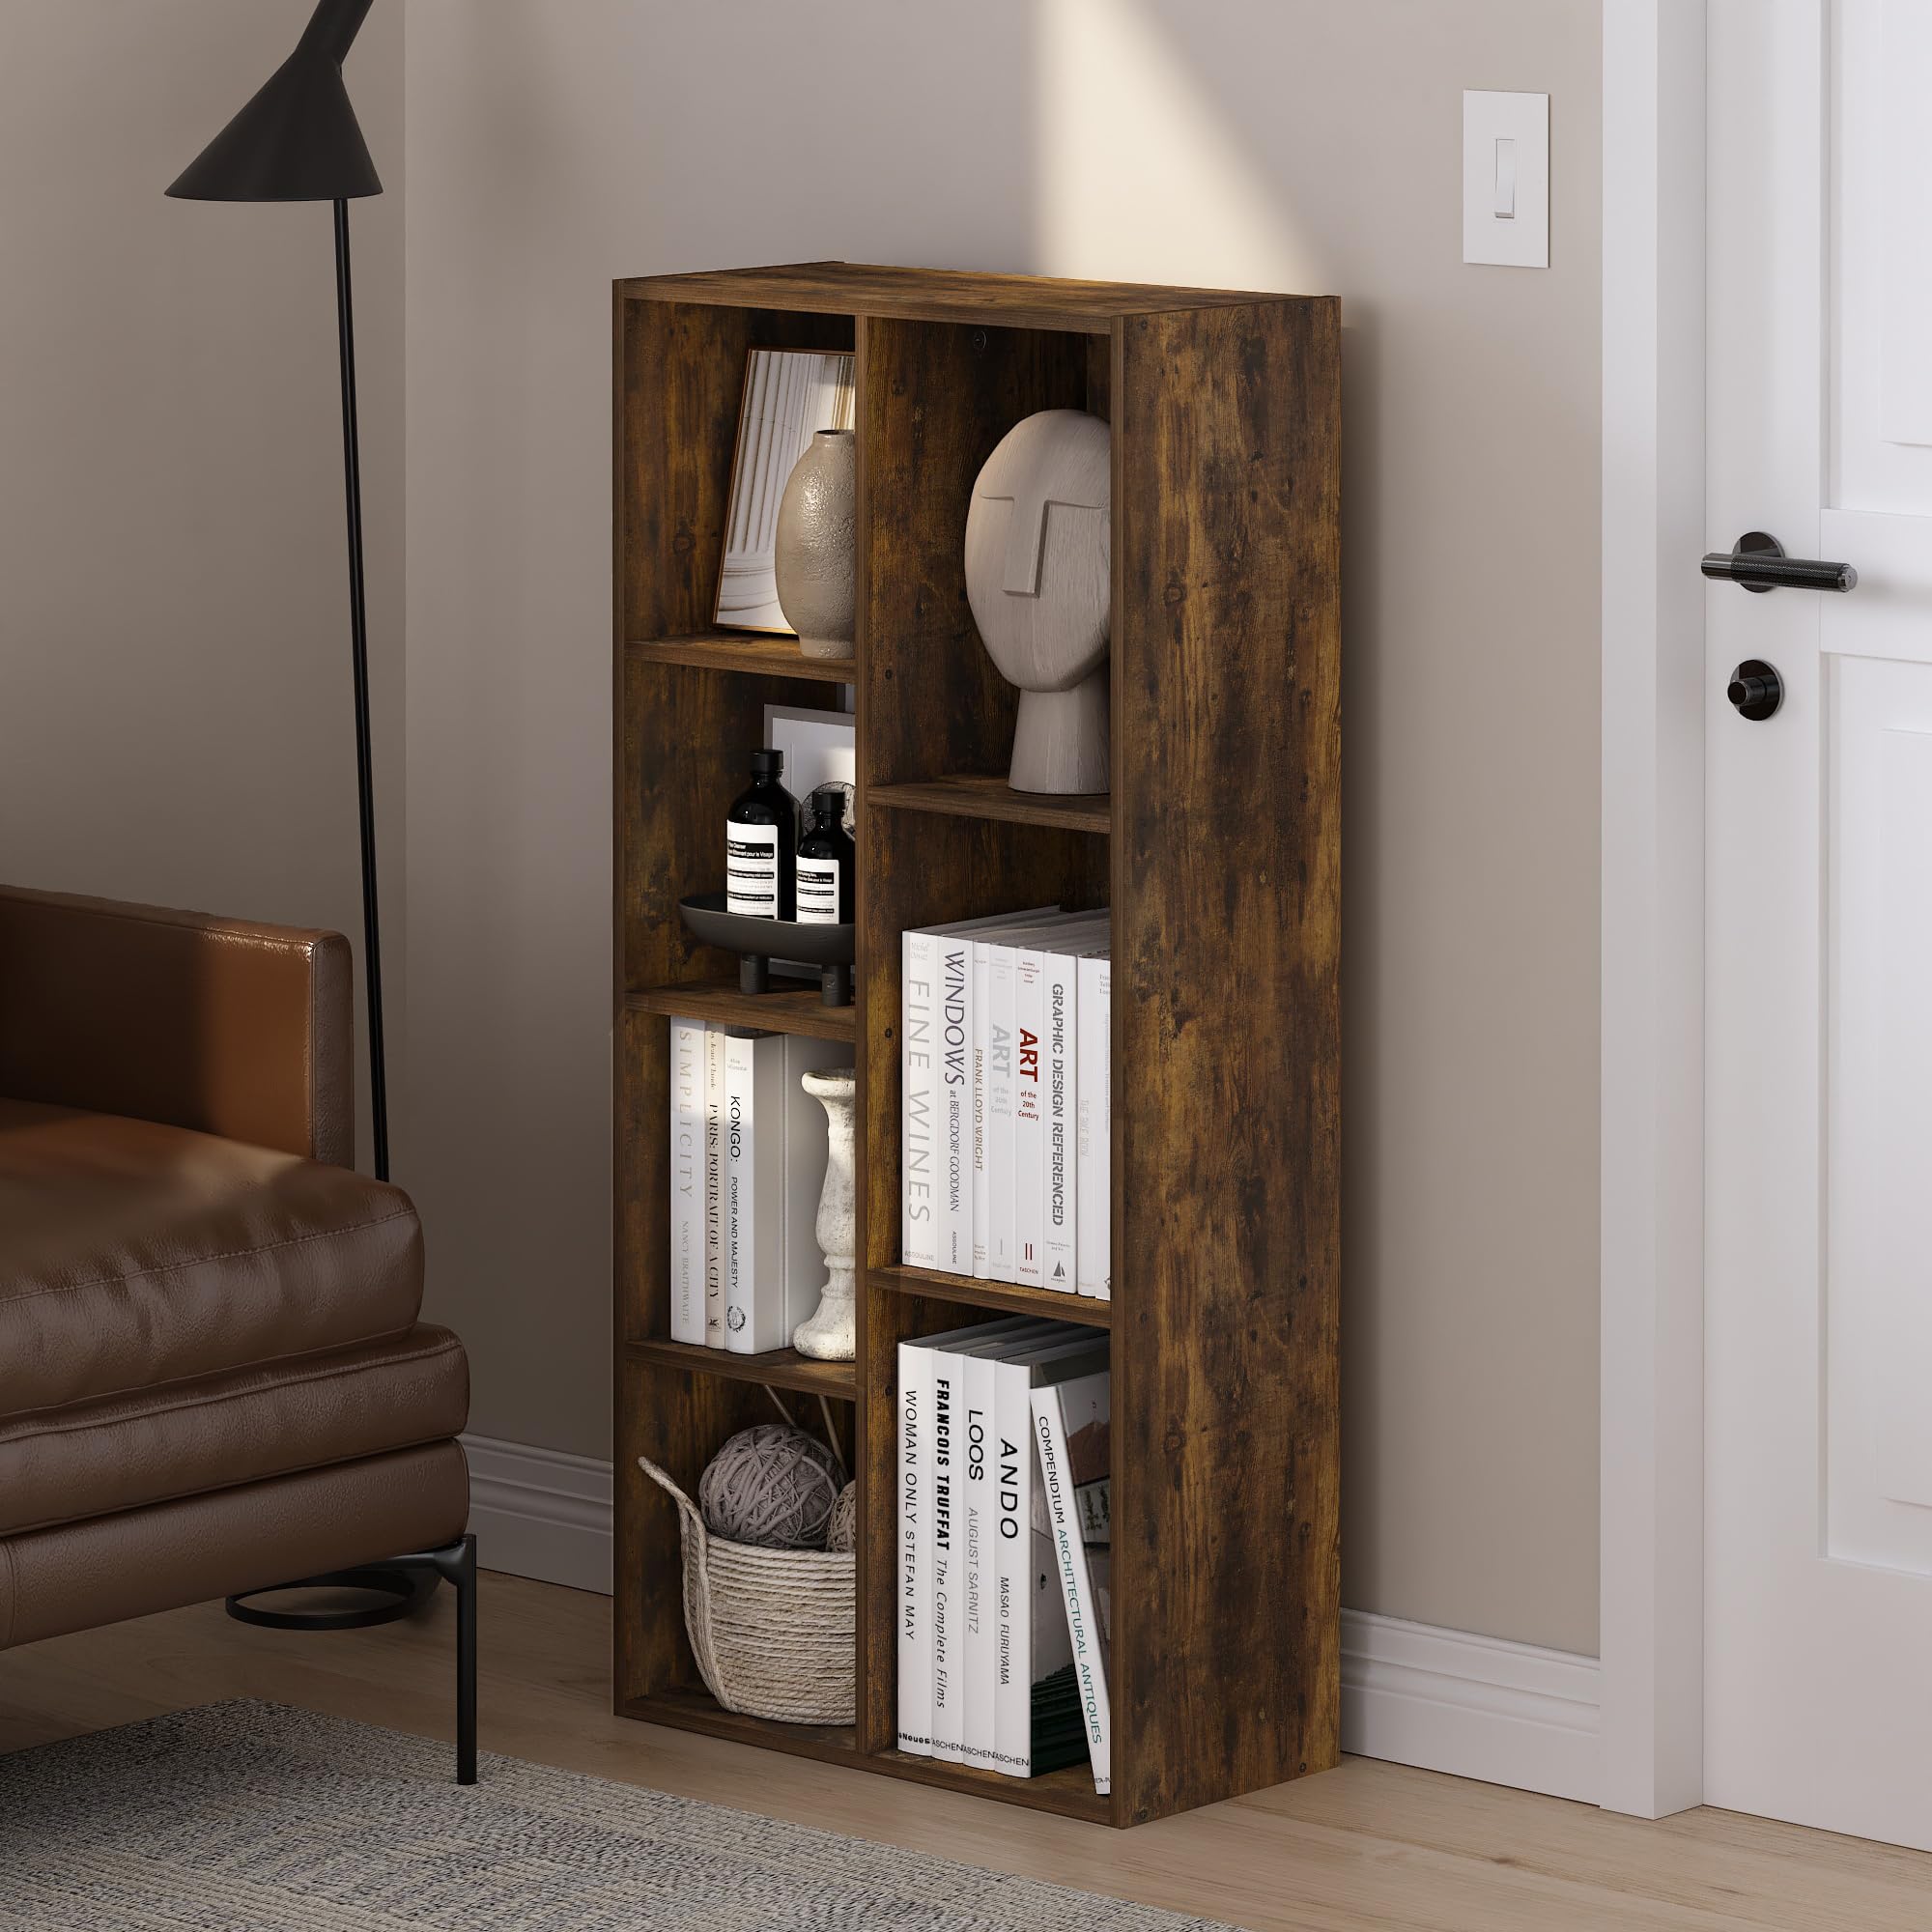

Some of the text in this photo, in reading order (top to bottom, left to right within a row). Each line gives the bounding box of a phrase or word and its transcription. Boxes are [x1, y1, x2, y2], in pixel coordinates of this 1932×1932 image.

[908, 980, 930, 1068] FINE
[992, 1023, 1010, 1079] ART
[1019, 1027, 1038, 1083] ART
[679, 1031, 693, 1198] SIMPLICITY
[945, 951, 965, 1212] WINDOWS at BERGDORF GOODMAN
[975, 1048, 983, 1171] FRANK LLOYD WRIGHT
[1017, 1110, 1039, 1122] Century
[1022, 1100, 1036, 1109] 20th
[1027, 1091, 1037, 1099] the
[1052, 983, 1064, 1225] GRAPHIC DESIGN REFERENCED
[730, 1095, 741, 1163] KONGO:
[908, 1090, 930, 1221] WINES
[709, 1153, 719, 1227] PORTRAIT
[709, 1230, 719, 1250] OF
[709, 1265, 719, 1301] CITY
[905, 1390, 918, 1639] WOMAN ONLY STEFAN MAY
[934, 1378, 951, 1709] FRANCOIS TRUFFAT The Complete Films
[968, 1409, 984, 1634] LOOS AUGUST SARNITZ
[1000, 1437, 1019, 1685] ANDO MASAO FURUYAMA
[1038, 1416, 1102, 1744] COMPENDIUM ARCHITECTURAL ANTIQUES
[931, 1739, 963, 1751] ASCHEN
